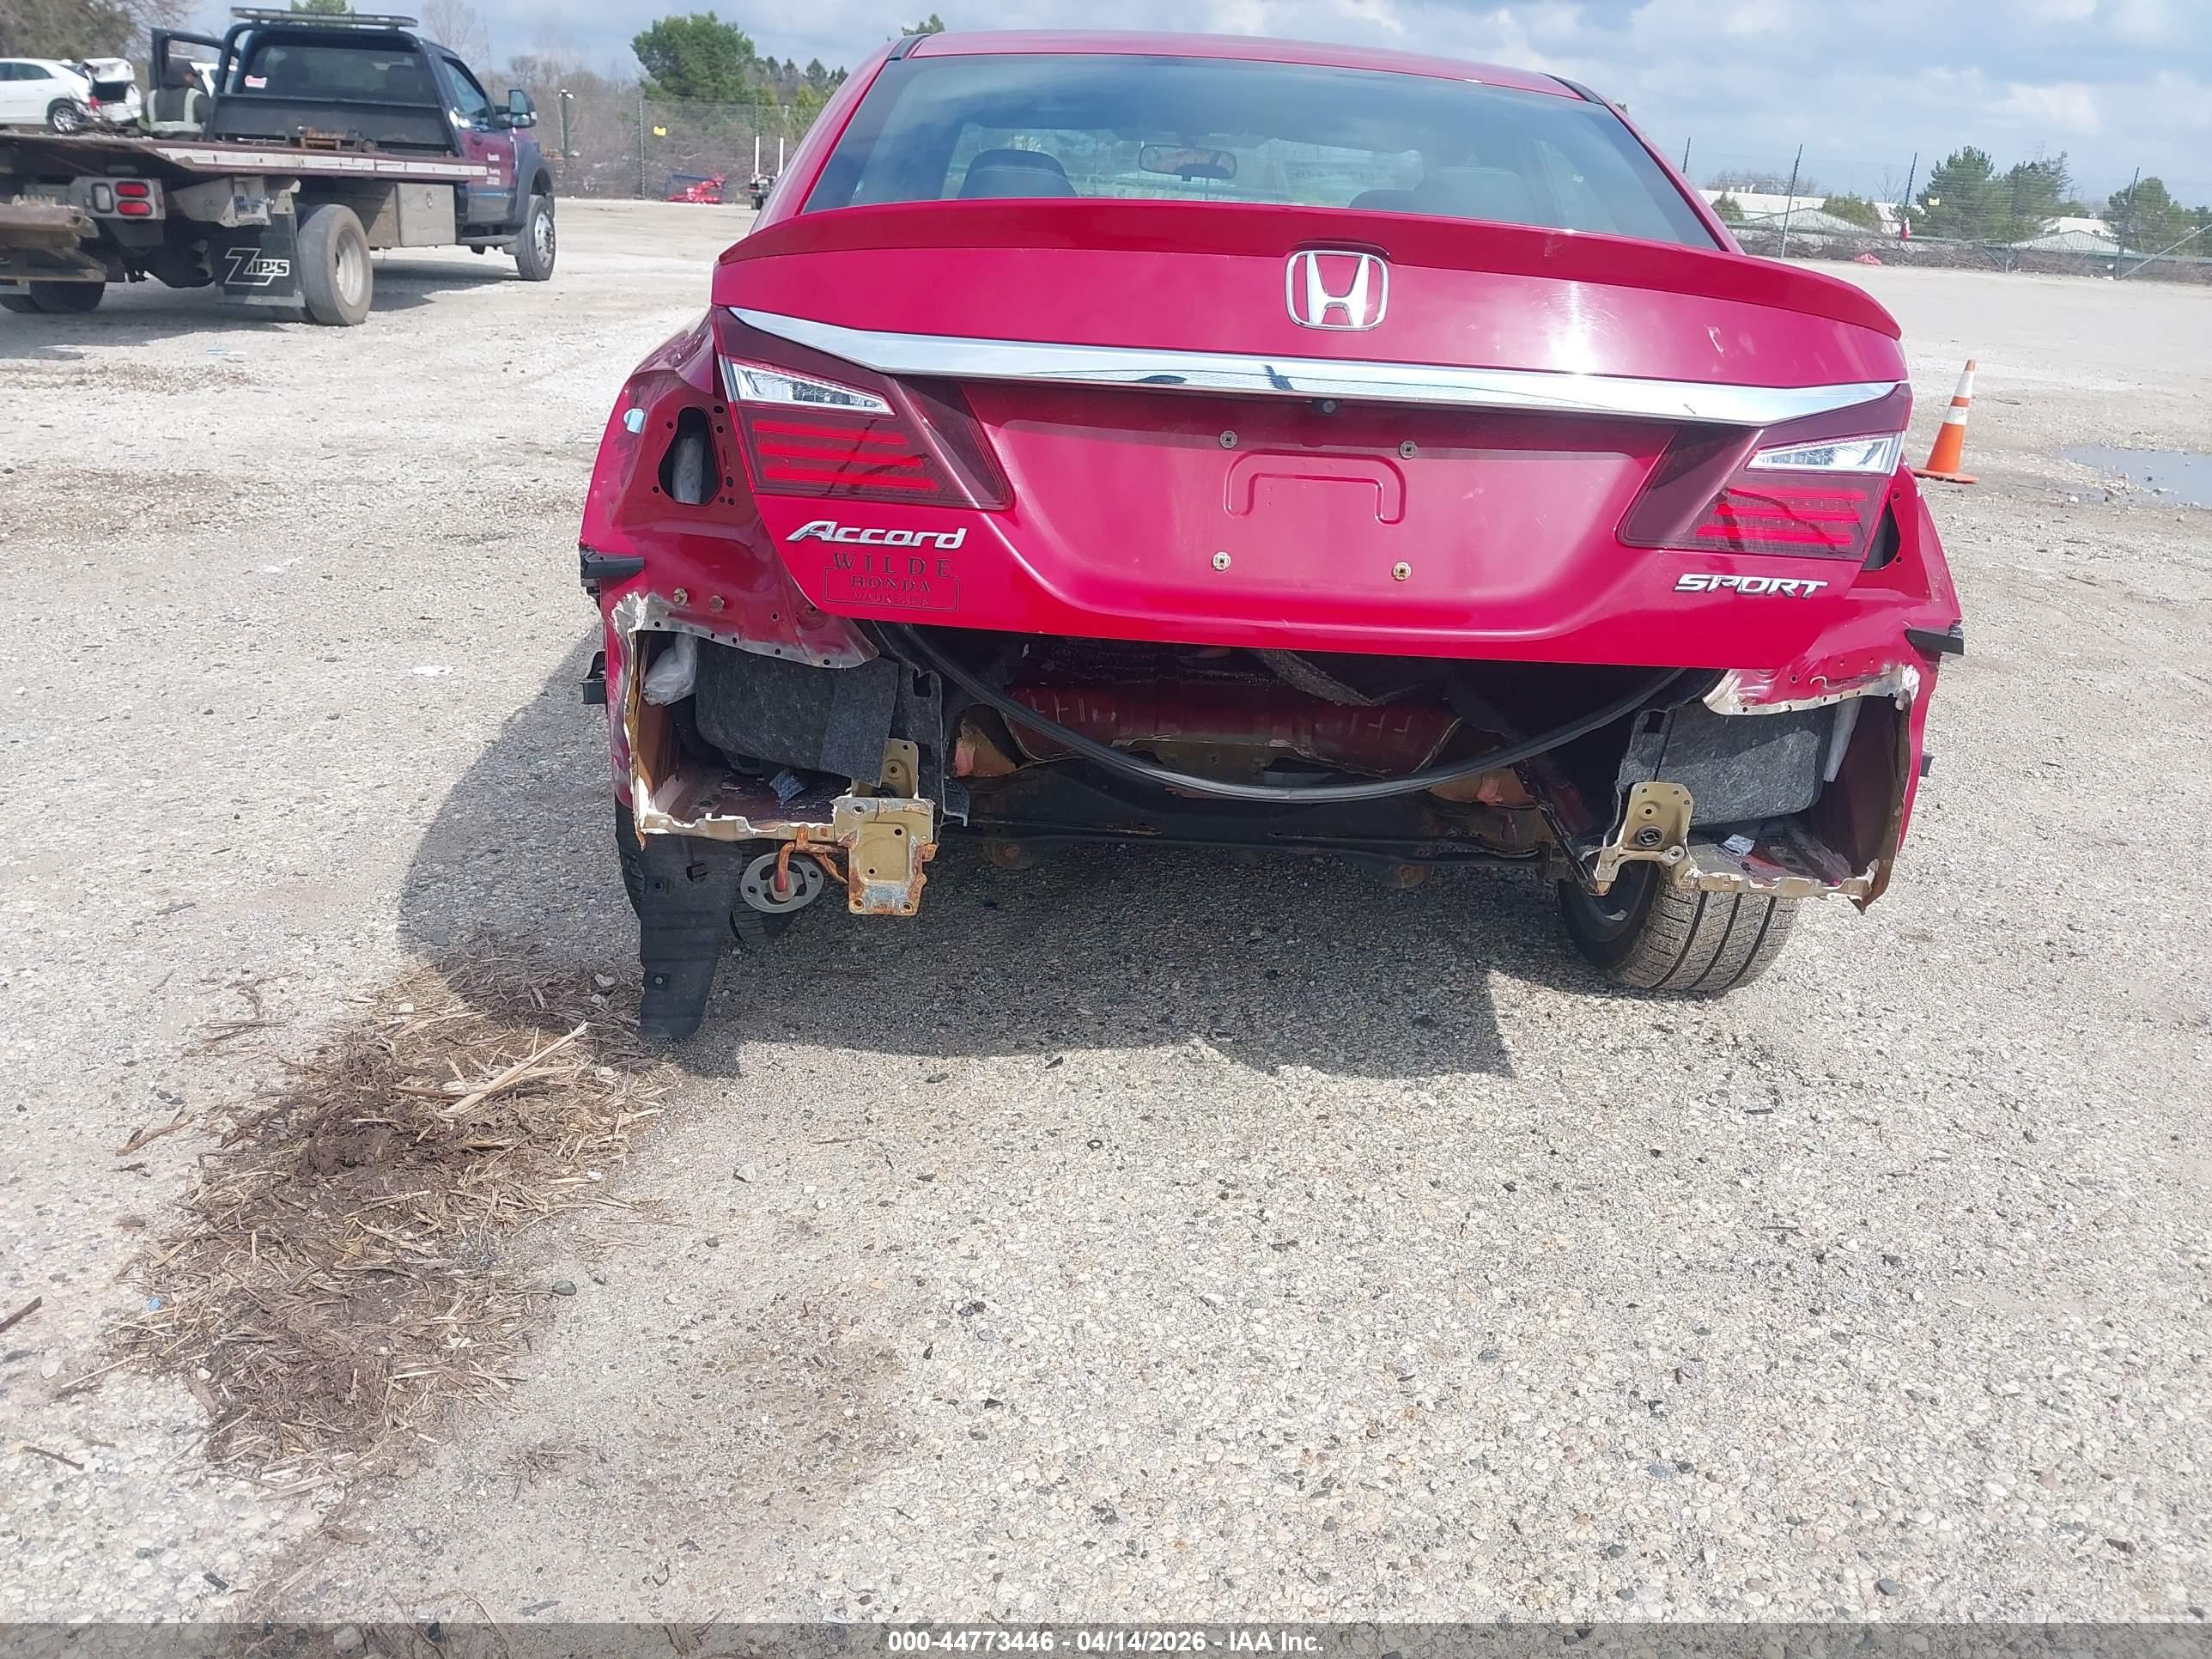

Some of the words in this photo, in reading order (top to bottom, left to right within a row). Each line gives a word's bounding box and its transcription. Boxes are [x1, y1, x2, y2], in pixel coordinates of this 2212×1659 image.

[786, 520, 968, 550] Accord
[833, 551, 951, 578] WILDE
[851, 575, 931, 592] HONDA
[1674, 573, 1828, 599] SPORT
